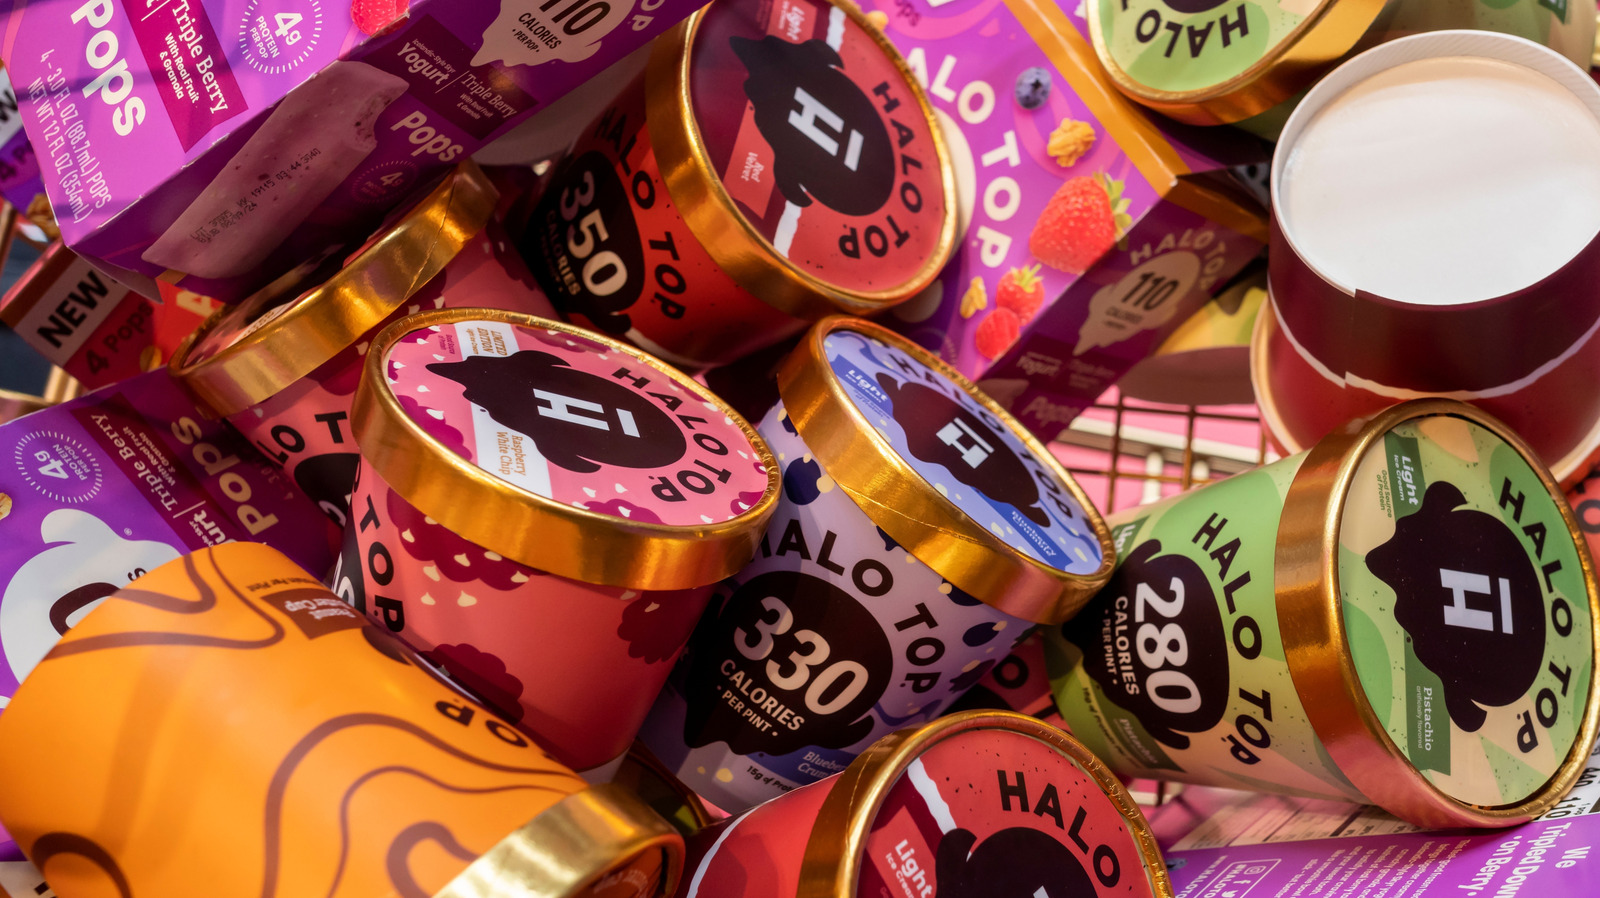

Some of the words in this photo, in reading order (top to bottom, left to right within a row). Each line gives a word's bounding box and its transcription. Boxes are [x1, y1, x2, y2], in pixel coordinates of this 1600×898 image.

[274, 12, 303, 46] 4g
[518, 12, 562, 50] CALORIES
[632, 0, 665, 31] OP
[786, 5, 805, 41] Light
[1135, 6, 1249, 59] HALO
[40, 48, 55, 63] 4
[159, 50, 168, 60] &
[249, 26, 262, 46] PER
[256, 43, 270, 60] POP
[256, 15, 280, 59] PROTEIN
[513, 29, 528, 44] PER
[525, 38, 539, 52] POP
[71, 0, 146, 136] Pops
[165, 32, 179, 57] With
[172, 53, 188, 79] Real
[182, 75, 200, 104] Fruit
[172, 2, 203, 58] Triple
[196, 54, 228, 114] Berry
[397, 42, 450, 86] Yogurt
[27, 77, 48, 105] NET
[47, 68, 66, 92] 3.0
[54, 86, 71, 109] FL
[163, 57, 184, 100] Granola
[462, 71, 494, 101] Triple
[487, 93, 518, 119] Berry
[36, 99, 55, 123] WT
[60, 103, 79, 126] OZ
[43, 120, 60, 141] 12
[48, 135, 66, 158] FL
[64, 120, 100, 178] (88.7mL)
[391, 111, 464, 162] Pops
[872, 81, 923, 214] HALO
[55, 152, 74, 175] OZ
[749, 161, 764, 182] Red
[907, 47, 996, 124] ALO
[977, 130, 1021, 267] TOP
[59, 169, 94, 224] (354mL)
[87, 170, 113, 210] POPS
[594, 106, 656, 210] HALO
[650, 231, 687, 320] TOP
[560, 170, 628, 297] 350
[1130, 229, 1215, 266] HALO
[1121, 272, 1180, 311] 110
[86, 349, 109, 376] 4
[103, 299, 155, 352] Pops
[477, 327, 494, 354] EDITION
[491, 330, 508, 356] LIMITED
[847, 368, 888, 402] Light
[889, 352, 1006, 434] HALO
[611, 367, 729, 456] HALO
[63, 442, 79, 460] POP
[90, 412, 136, 462] Berry
[123, 425, 146, 450] Fruit
[136, 431, 171, 467] Granola
[138, 445, 159, 466] Real
[496, 431, 509, 457] White
[511, 433, 528, 477] Raspberry
[33, 450, 69, 480] 4g
[53, 443, 88, 481] PROTEIN
[76, 457, 90, 473] PER
[154, 464, 177, 487] With
[171, 416, 279, 535] Pops
[498, 456, 511, 477] Chip
[1376, 474, 1382, 483] of
[1402, 455, 1419, 506] Light
[134, 459, 178, 511] Triple
[1378, 482, 1386, 511] Protein
[1396, 469, 1405, 501] Cream
[1010, 510, 1057, 557] Blueberry
[1011, 516, 1052, 556] Crumble
[1498, 476, 1573, 638] HALO
[1192, 513, 1262, 660] HALO
[894, 602, 946, 694] TOP
[1102, 618, 1112, 645] PER
[1115, 596, 1140, 696] CALORIES
[1135, 577, 1202, 714] 280
[733, 596, 869, 716] 330
[1106, 643, 1117, 675] PINT
[720, 659, 805, 731] CALORIES
[721, 690, 745, 714] PER
[742, 704, 772, 734] PINT
[435, 700, 535, 752] OP
[1423, 686, 1433, 752] Pistachio
[746, 765, 763, 780] 15g
[763, 777, 774, 785] of
[997, 769, 1121, 888] HALO
[1519, 822, 1572, 865] Tripled
[885, 852, 897, 870] Ice
[1492, 841, 1520, 856] on
[1555, 846, 1591, 869] We
[895, 838, 932, 898] Light
[1458, 857, 1512, 890] Berry
[1493, 865, 1540, 898] Dow
